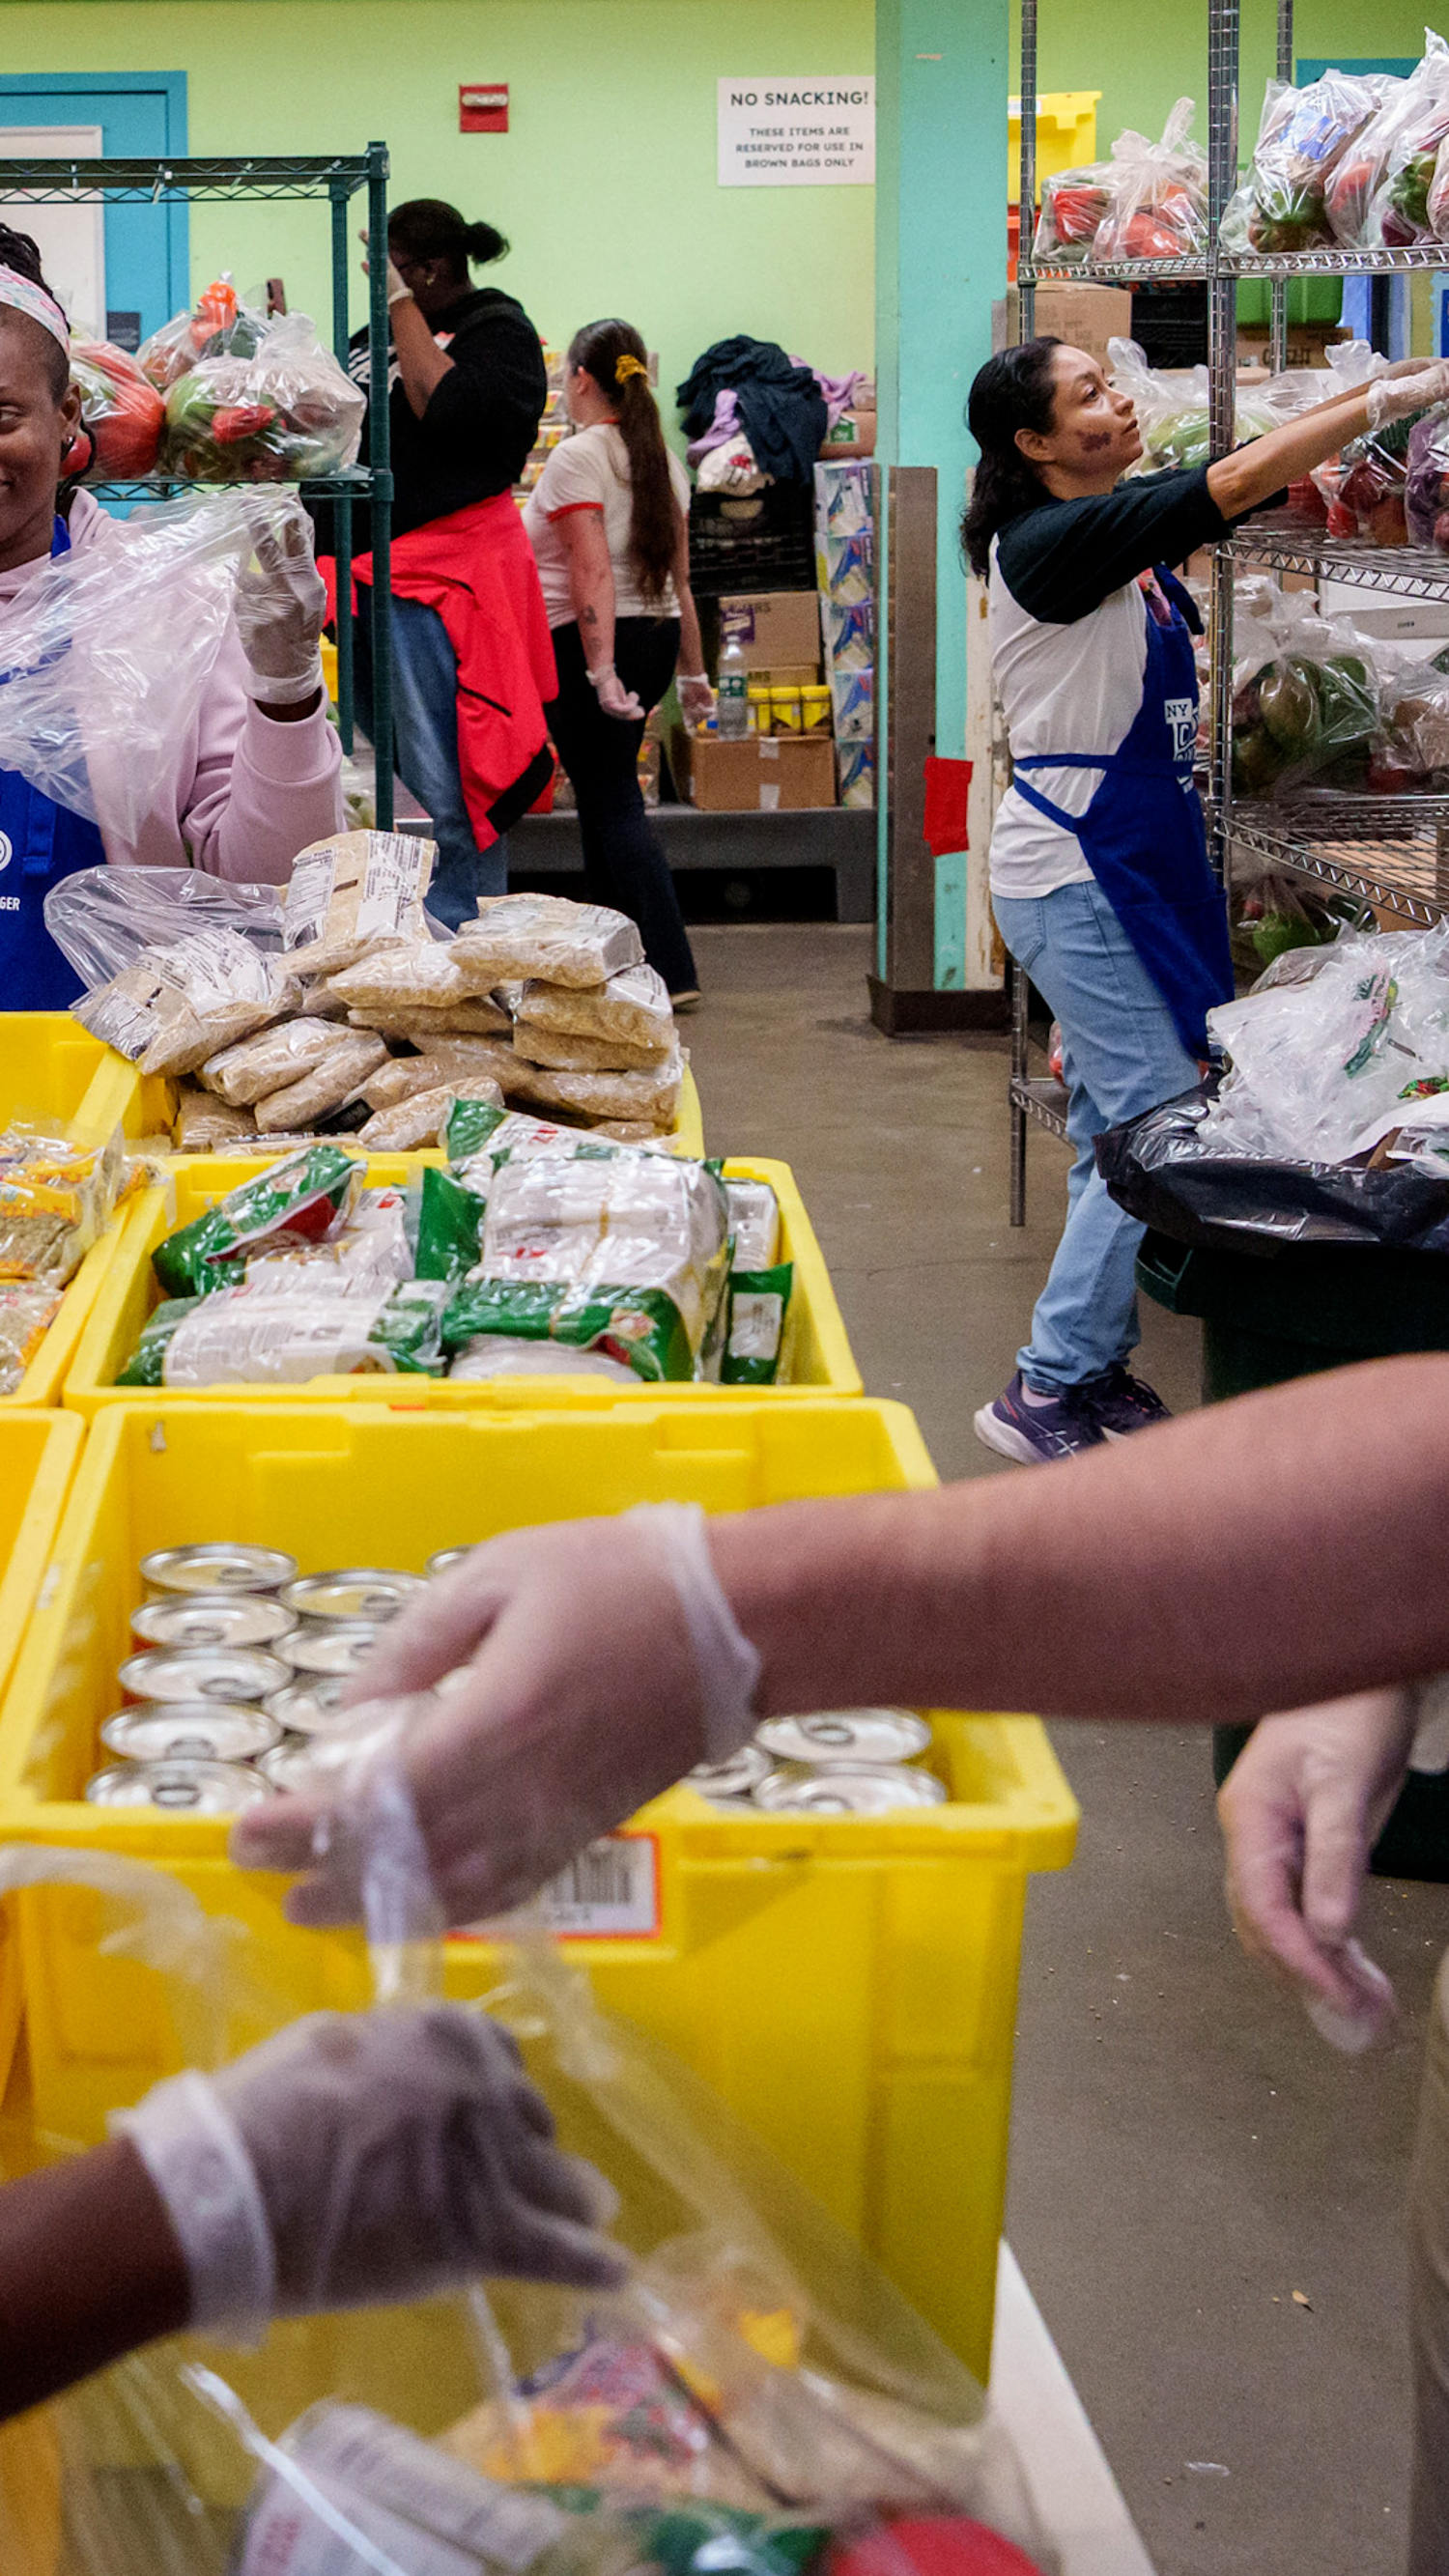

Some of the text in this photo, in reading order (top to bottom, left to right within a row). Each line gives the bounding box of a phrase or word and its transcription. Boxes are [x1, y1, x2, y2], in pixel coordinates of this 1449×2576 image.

[730, 92, 868, 106] NO SNACKING!
[750, 127, 850, 137] THESE ITEMS ARE
[735, 142, 864, 153] RESERVED FOR USE IN
[745, 158, 855, 168] BROWN BAGS ONLY
[1167, 704, 1187, 718] NY
